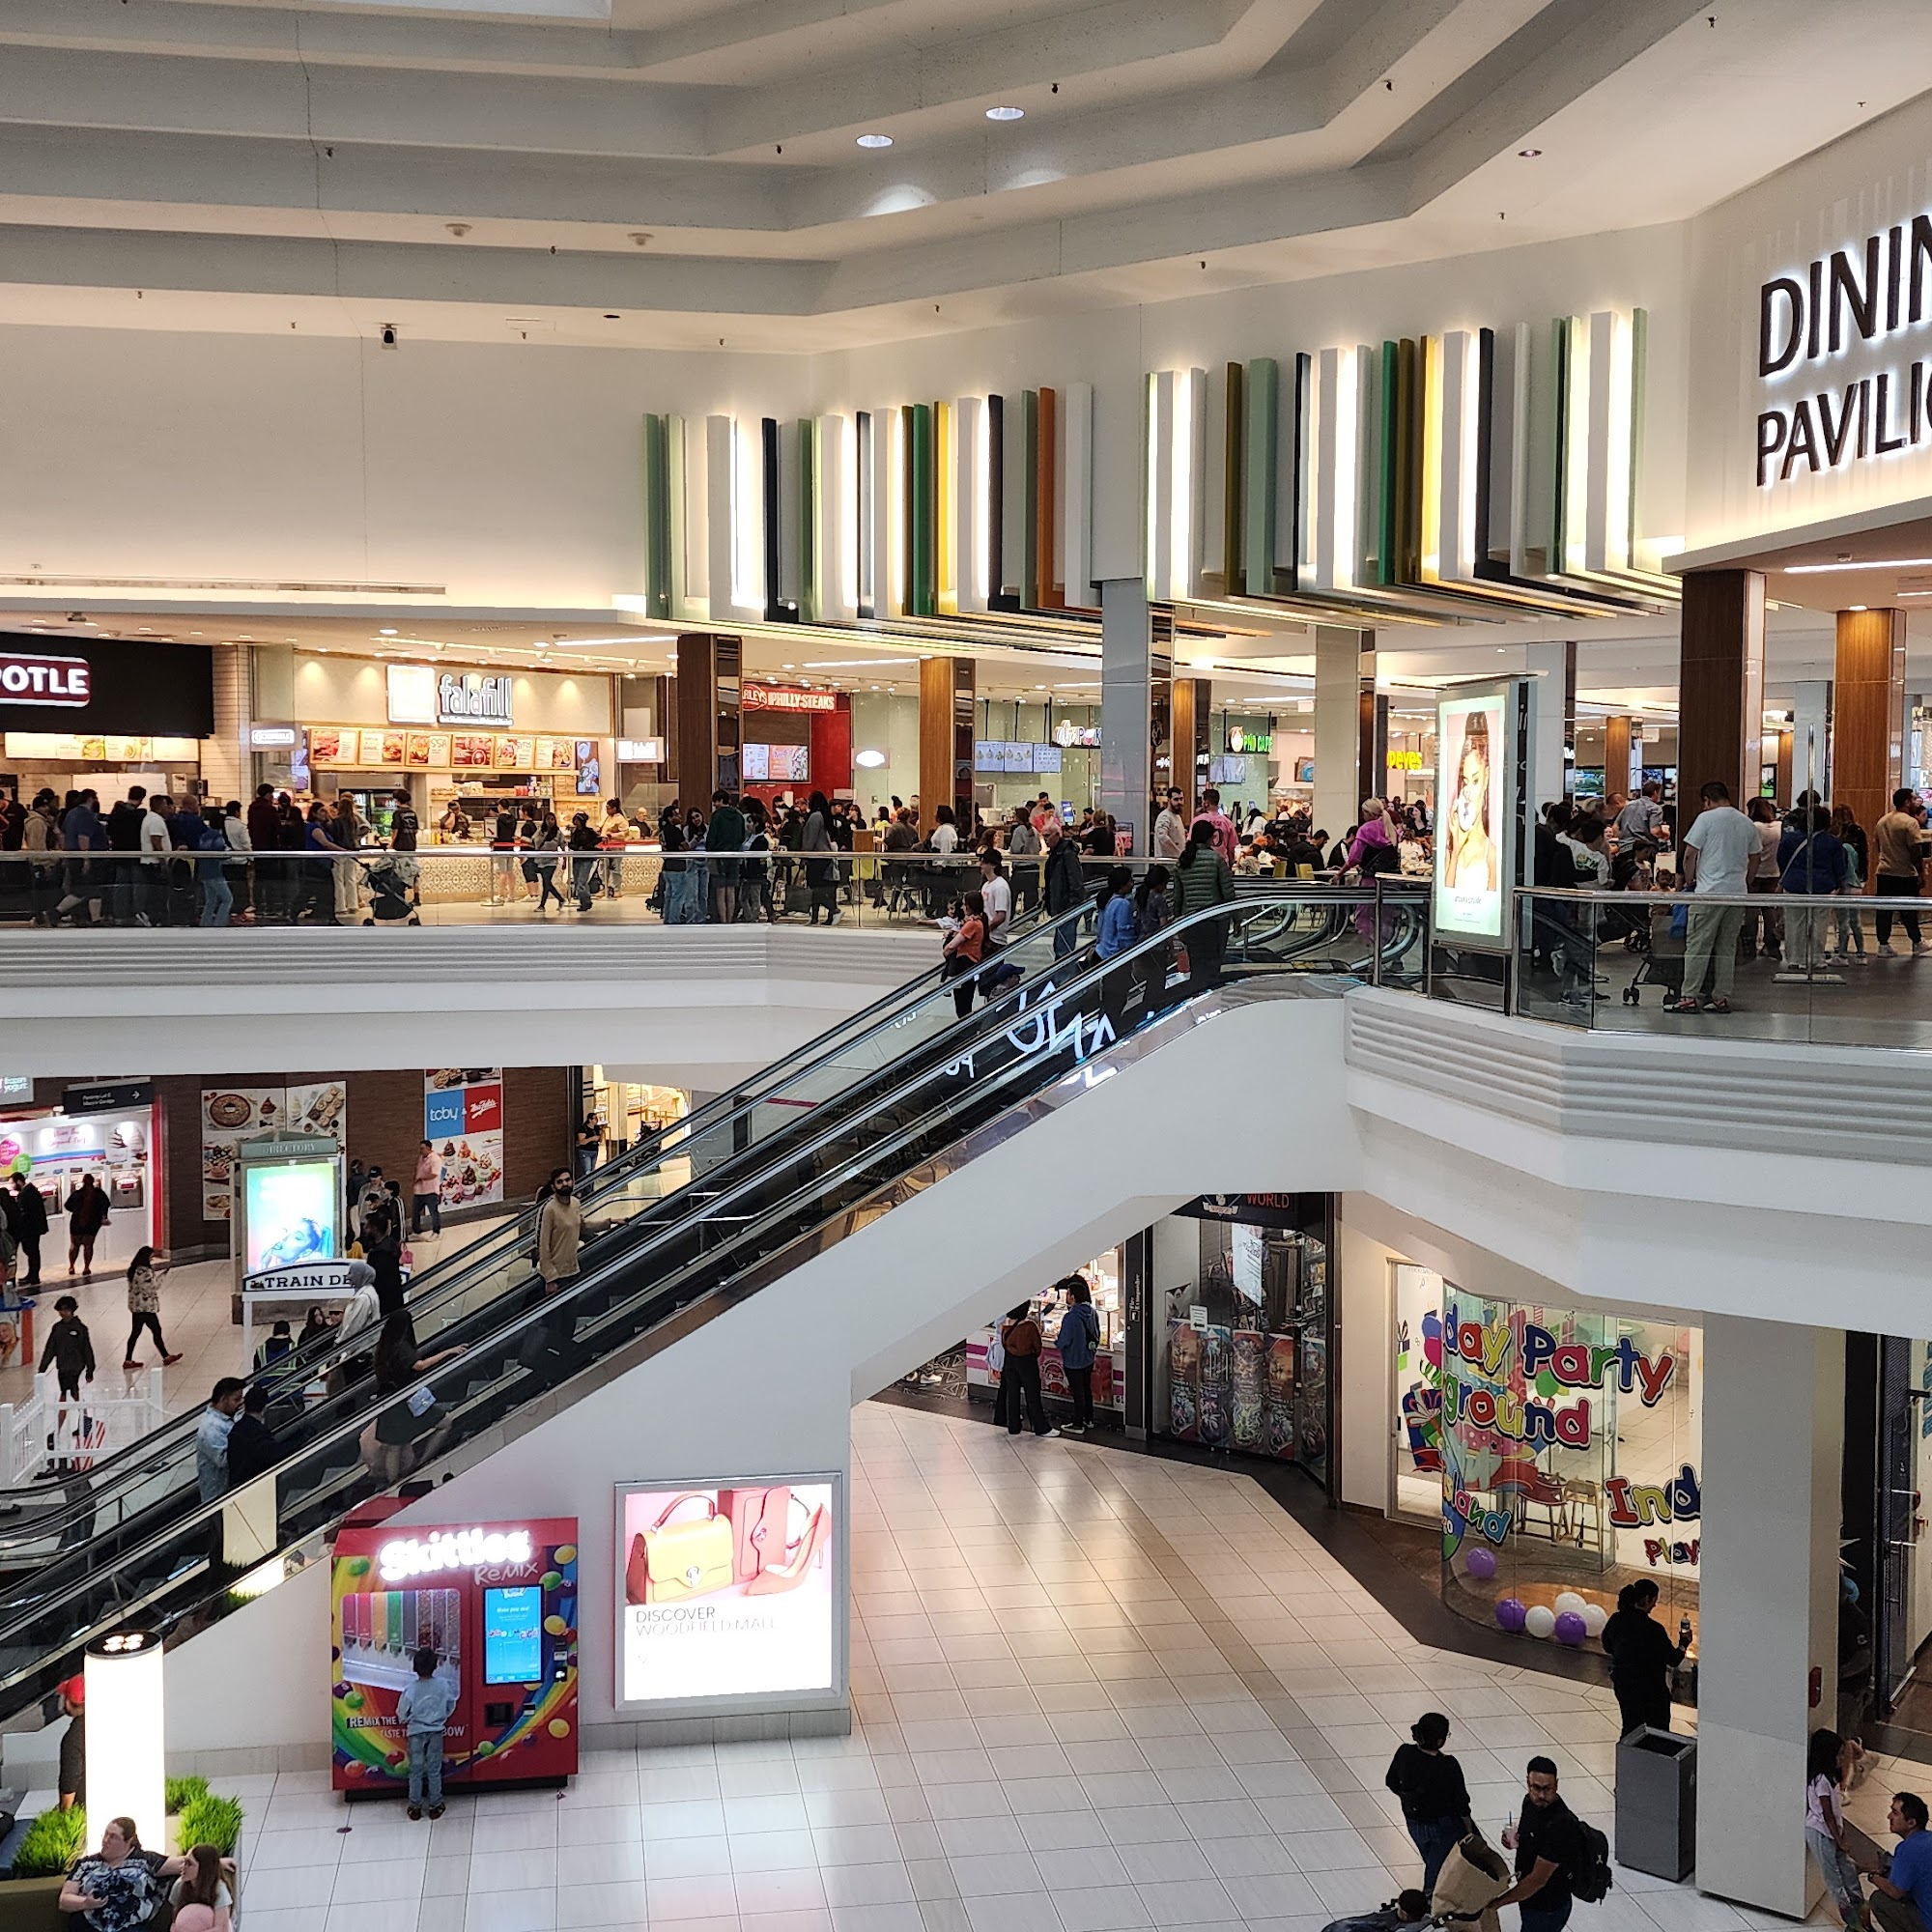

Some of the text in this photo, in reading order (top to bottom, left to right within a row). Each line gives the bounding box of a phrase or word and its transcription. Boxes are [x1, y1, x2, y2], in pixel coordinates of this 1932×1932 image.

[1756, 361, 1932, 487] PAVILI
[0, 665, 90, 695] OTLE
[440, 673, 513, 717] falafill
[770, 692, 800, 708] PHILLY
[800, 694, 835, 710] STEAKS
[1386, 750, 1423, 770] peyes
[430, 1107, 459, 1122] tcby
[263, 1142, 317, 1154] DIRECTORY
[1247, 1193, 1290, 1208] WORLD
[264, 1275, 324, 1288] TRAIN
[1444, 1302, 1676, 1407] day Party
[1443, 1372, 1592, 1450] ground
[1604, 1463, 1701, 1528] Ind
[379, 1527, 530, 1581] Skittles
[636, 1606, 716, 1623] DISCOVER
[636, 1617, 781, 1636] WOODFIELD MALL
[349, 1717, 382, 1728] REMIX
[382, 1716, 397, 1726] THE
[381, 1728, 401, 1738] TASTE
